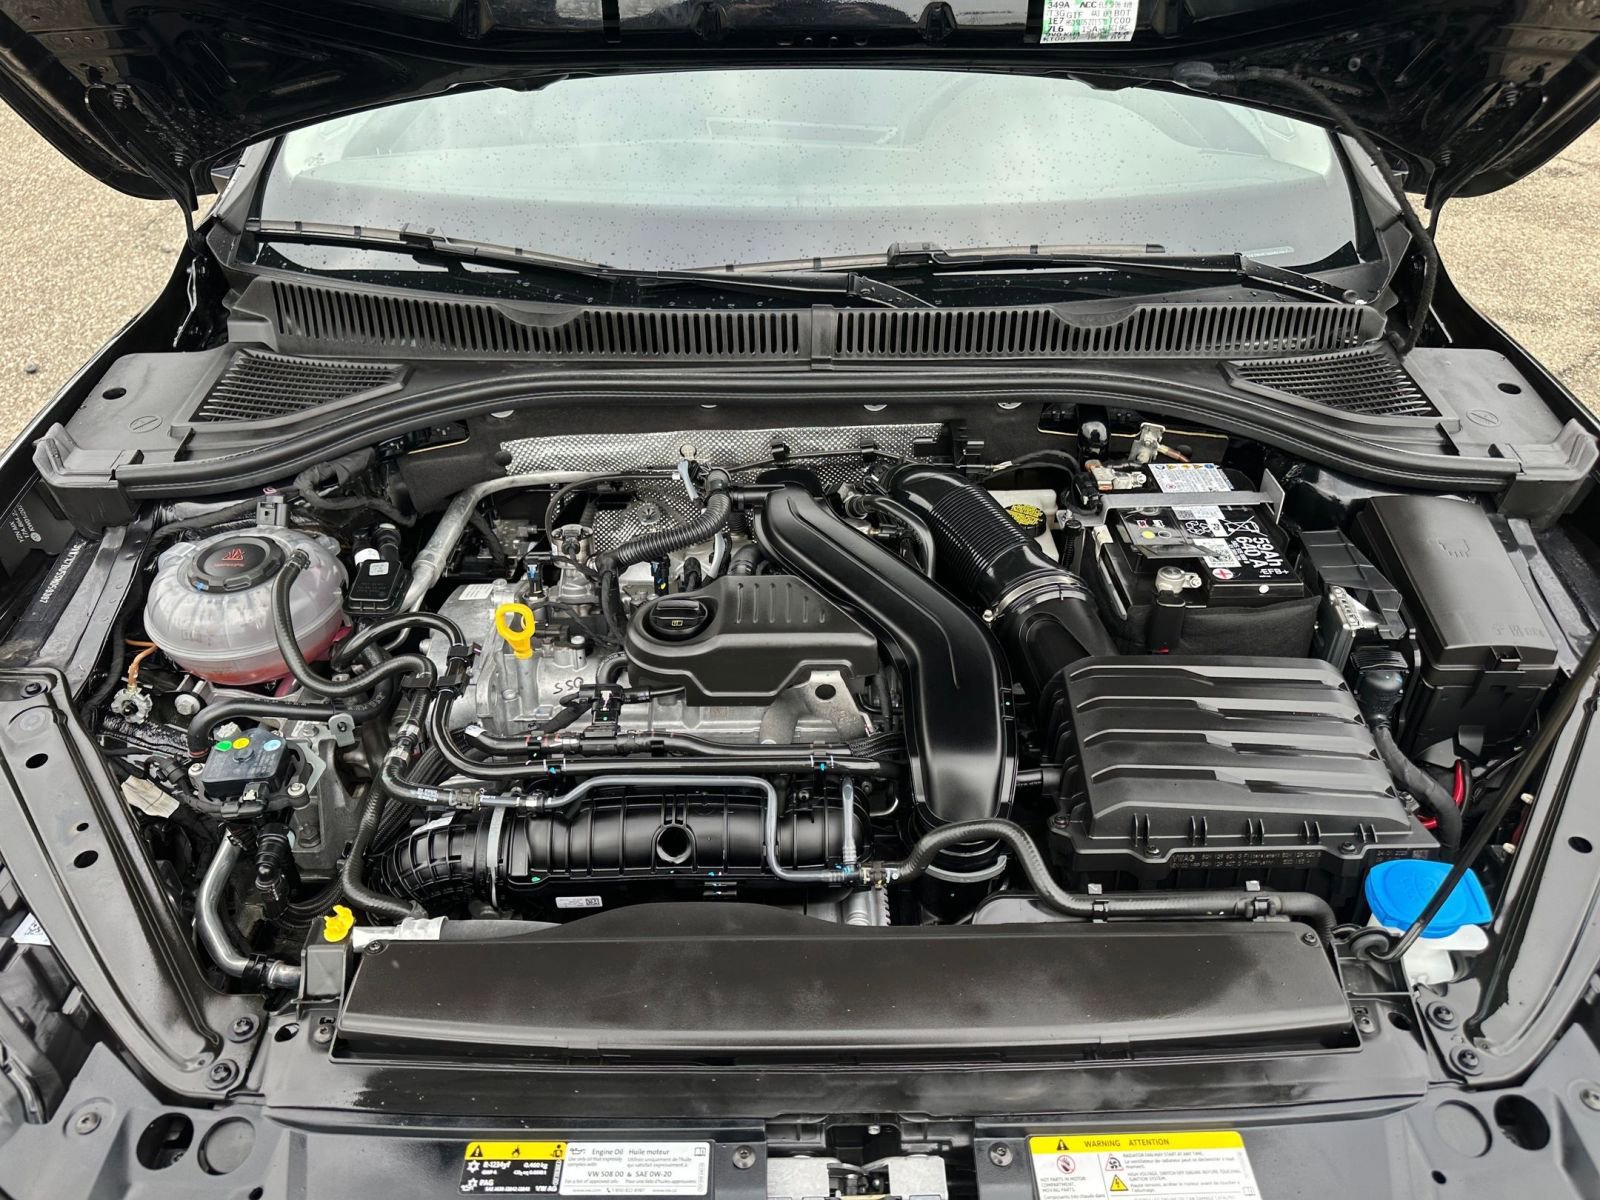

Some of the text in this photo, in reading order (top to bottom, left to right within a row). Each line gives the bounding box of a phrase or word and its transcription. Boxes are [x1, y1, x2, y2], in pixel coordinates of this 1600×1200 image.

[1252, 537, 1284, 567] 59Ah
[1084, 1138, 1170, 1148] WARNING ATTENTION
[592, 1148, 613, 1156] Engine
